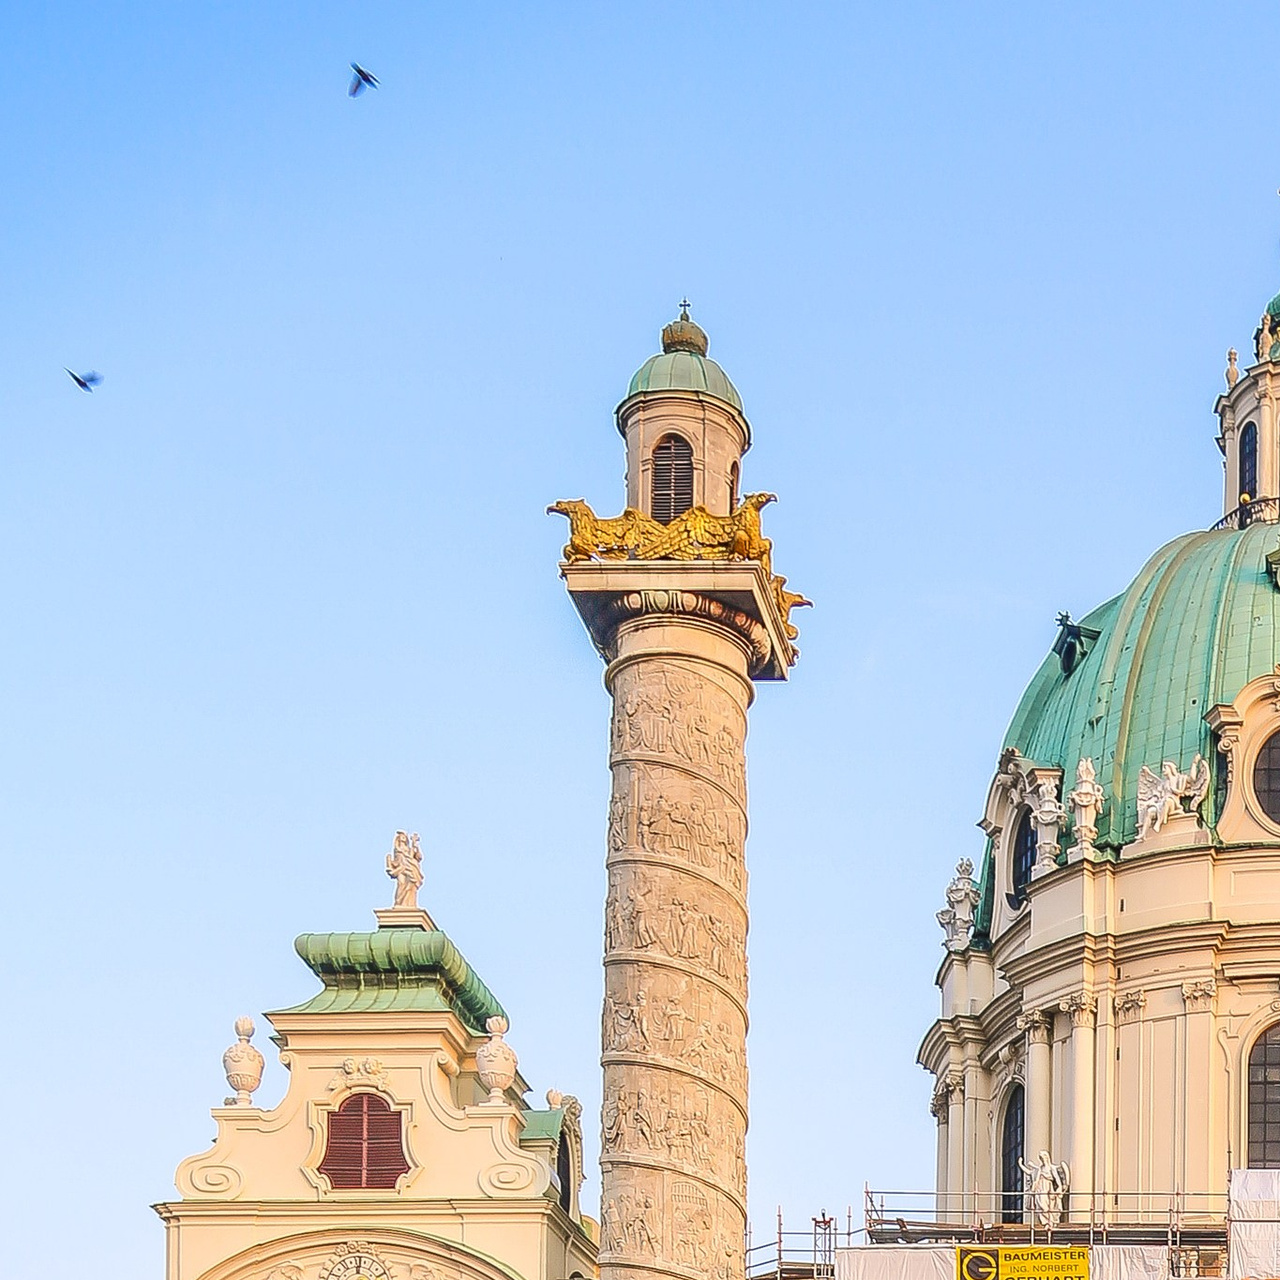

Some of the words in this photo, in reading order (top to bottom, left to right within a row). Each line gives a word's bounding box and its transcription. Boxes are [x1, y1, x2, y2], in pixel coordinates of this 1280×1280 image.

[1004, 1251, 1086, 1262] BAUMEISTER
[1009, 1265, 1030, 1273] ING.
[1032, 1264, 1079, 1273] NORBERT
